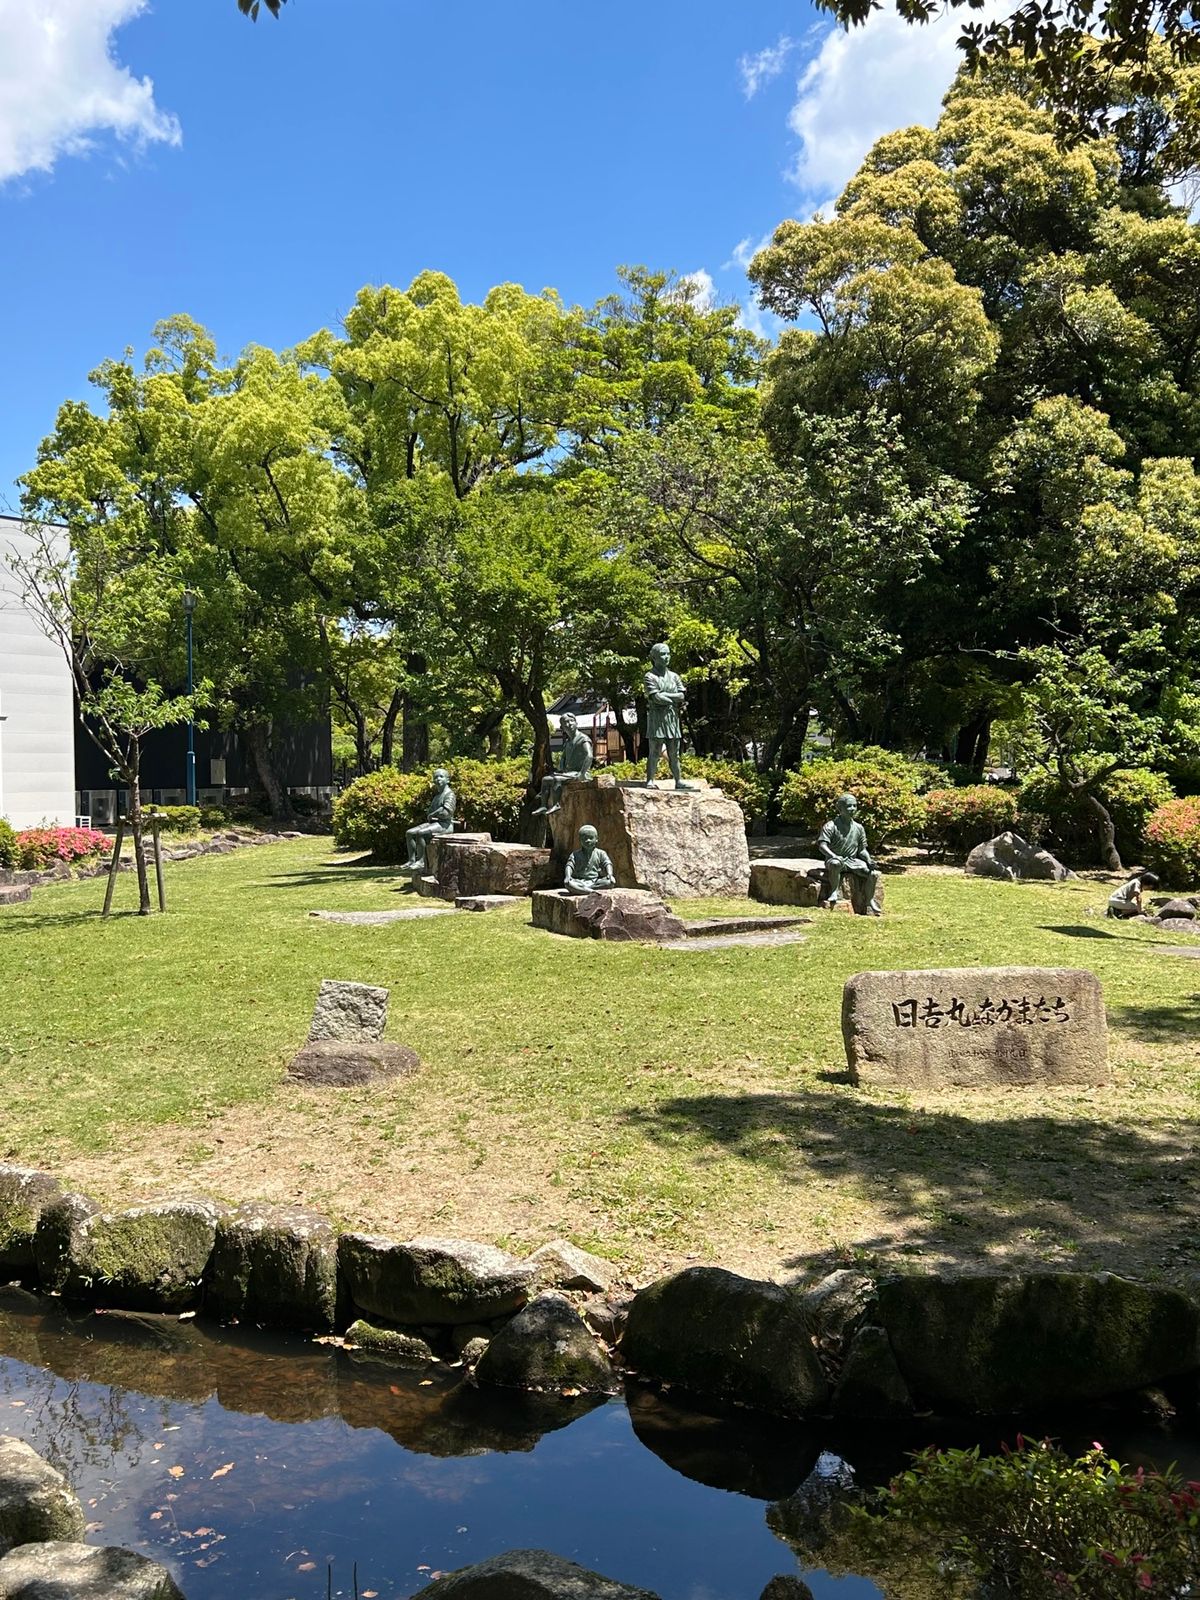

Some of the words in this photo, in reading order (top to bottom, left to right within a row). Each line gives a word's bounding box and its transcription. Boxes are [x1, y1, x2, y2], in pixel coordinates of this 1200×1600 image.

[892, 996, 1070, 1029] 日吉丸となかまたち
